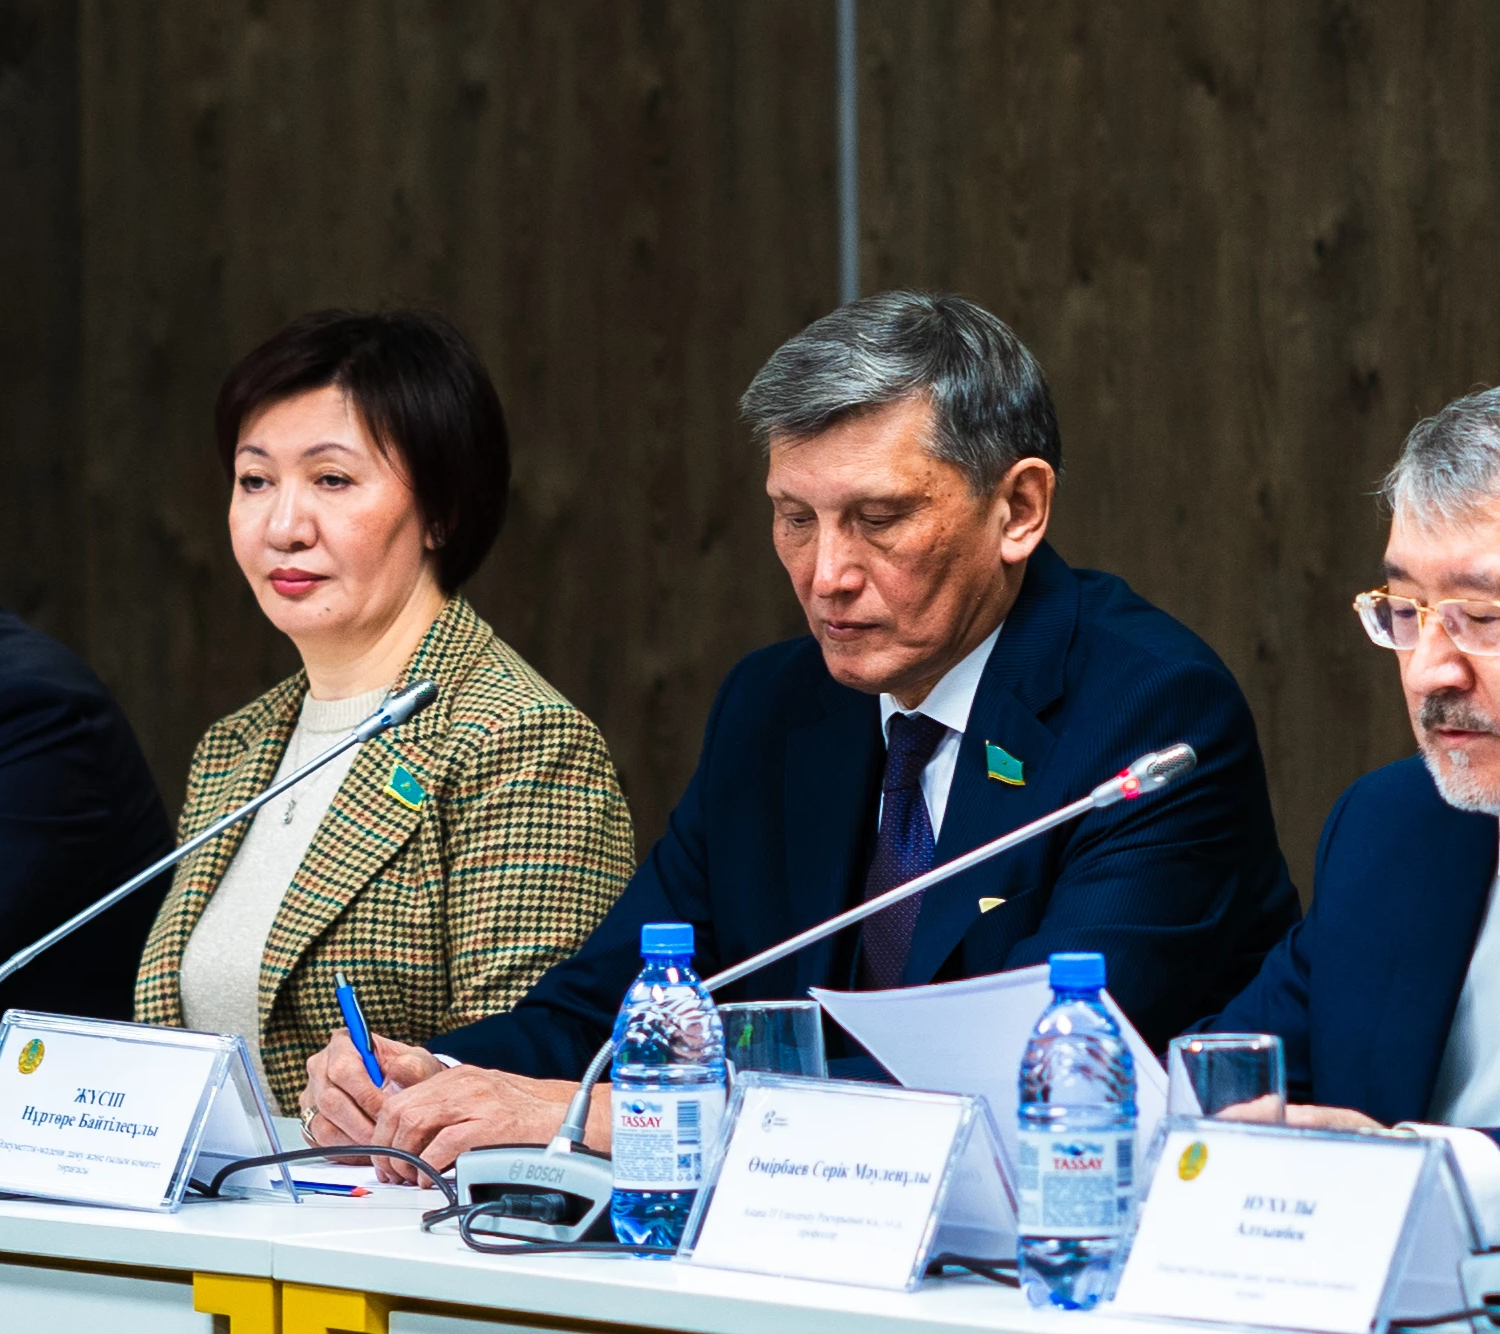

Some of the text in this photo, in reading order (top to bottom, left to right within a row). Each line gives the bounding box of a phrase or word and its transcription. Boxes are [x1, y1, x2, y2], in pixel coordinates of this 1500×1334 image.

[74, 1087, 126, 1108] ЖҮСІП
[21, 1105, 160, 1139] Нұртөре Байтілесұлы
[621, 1115, 662, 1128] TASSAY
[526, 1164, 565, 1184] BOSCH
[749, 1156, 809, 1178] Өмірбаев
[812, 1160, 849, 1182] Серік
[1053, 1158, 1102, 1170] TASSAY
